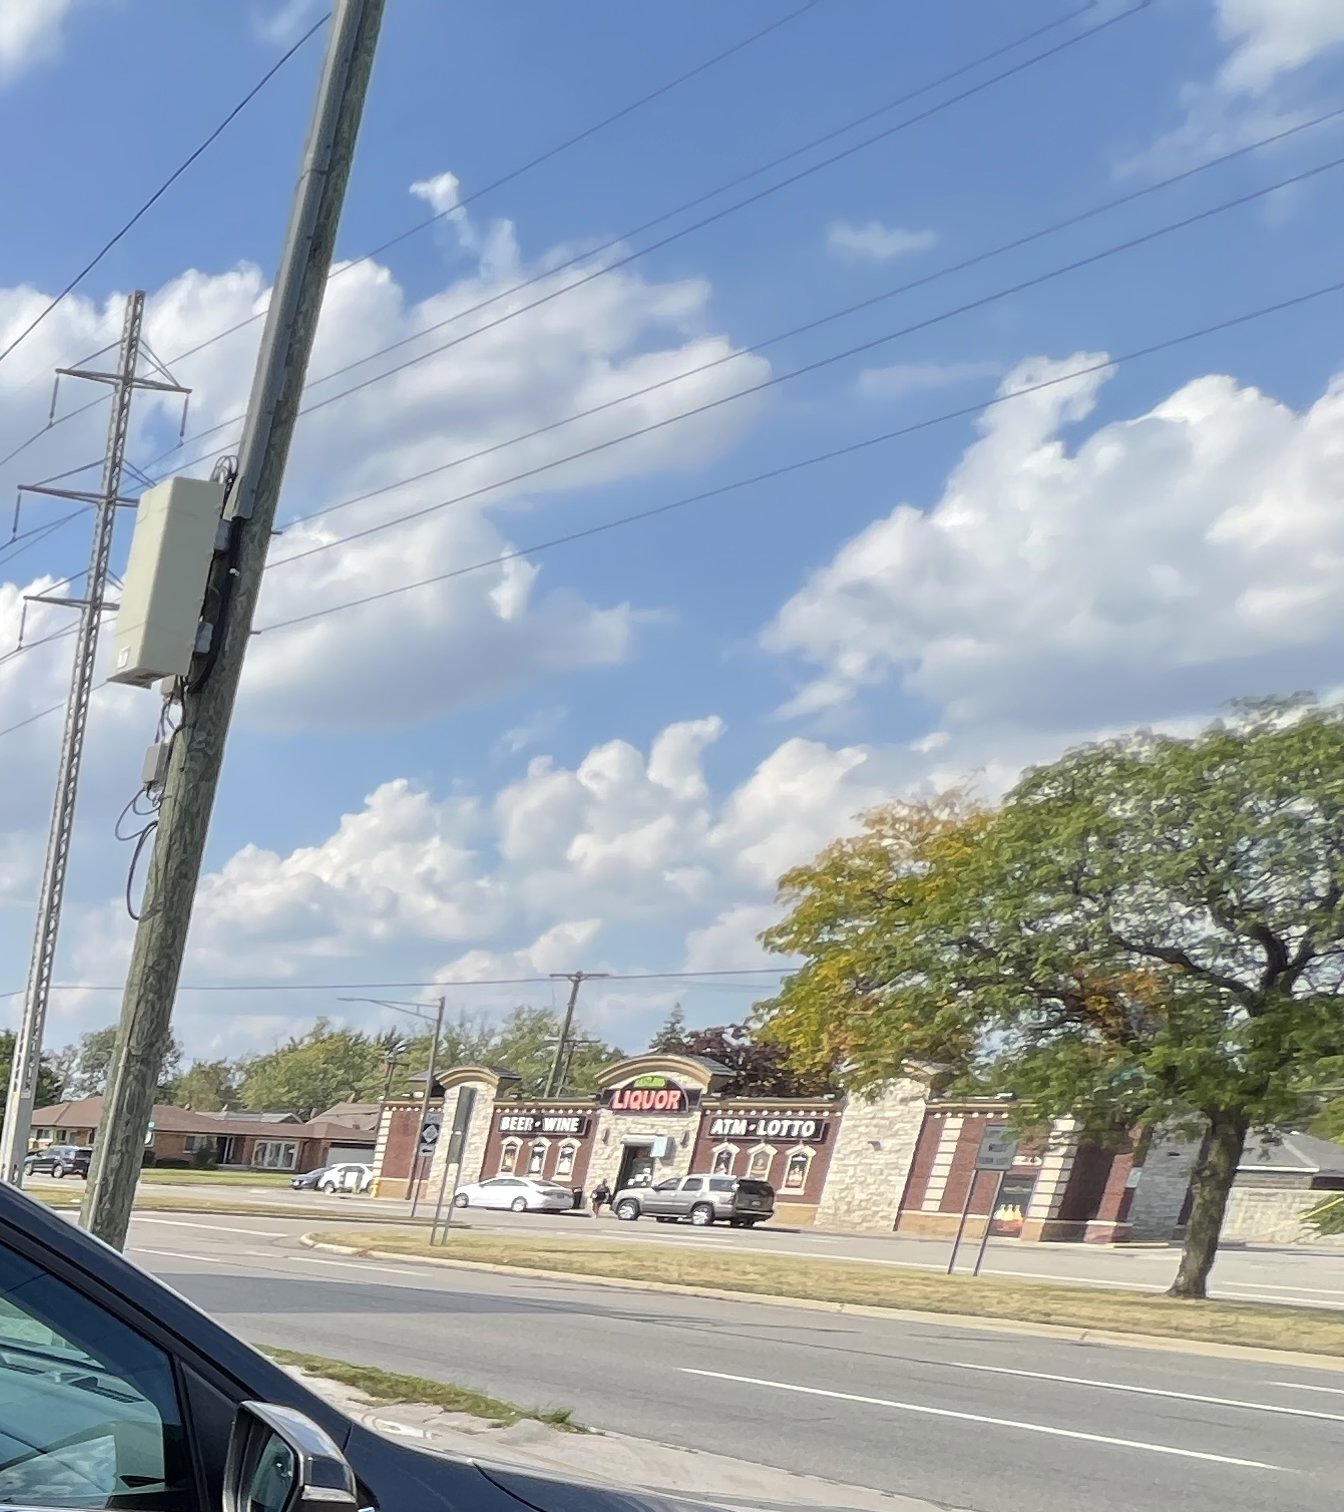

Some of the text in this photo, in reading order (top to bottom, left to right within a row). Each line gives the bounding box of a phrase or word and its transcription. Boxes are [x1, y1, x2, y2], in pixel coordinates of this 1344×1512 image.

[611, 1089, 682, 1111] LIQUOR
[499, 1116, 580, 1132] BEER WINE
[709, 1118, 816, 1137] ATM LOTTO
